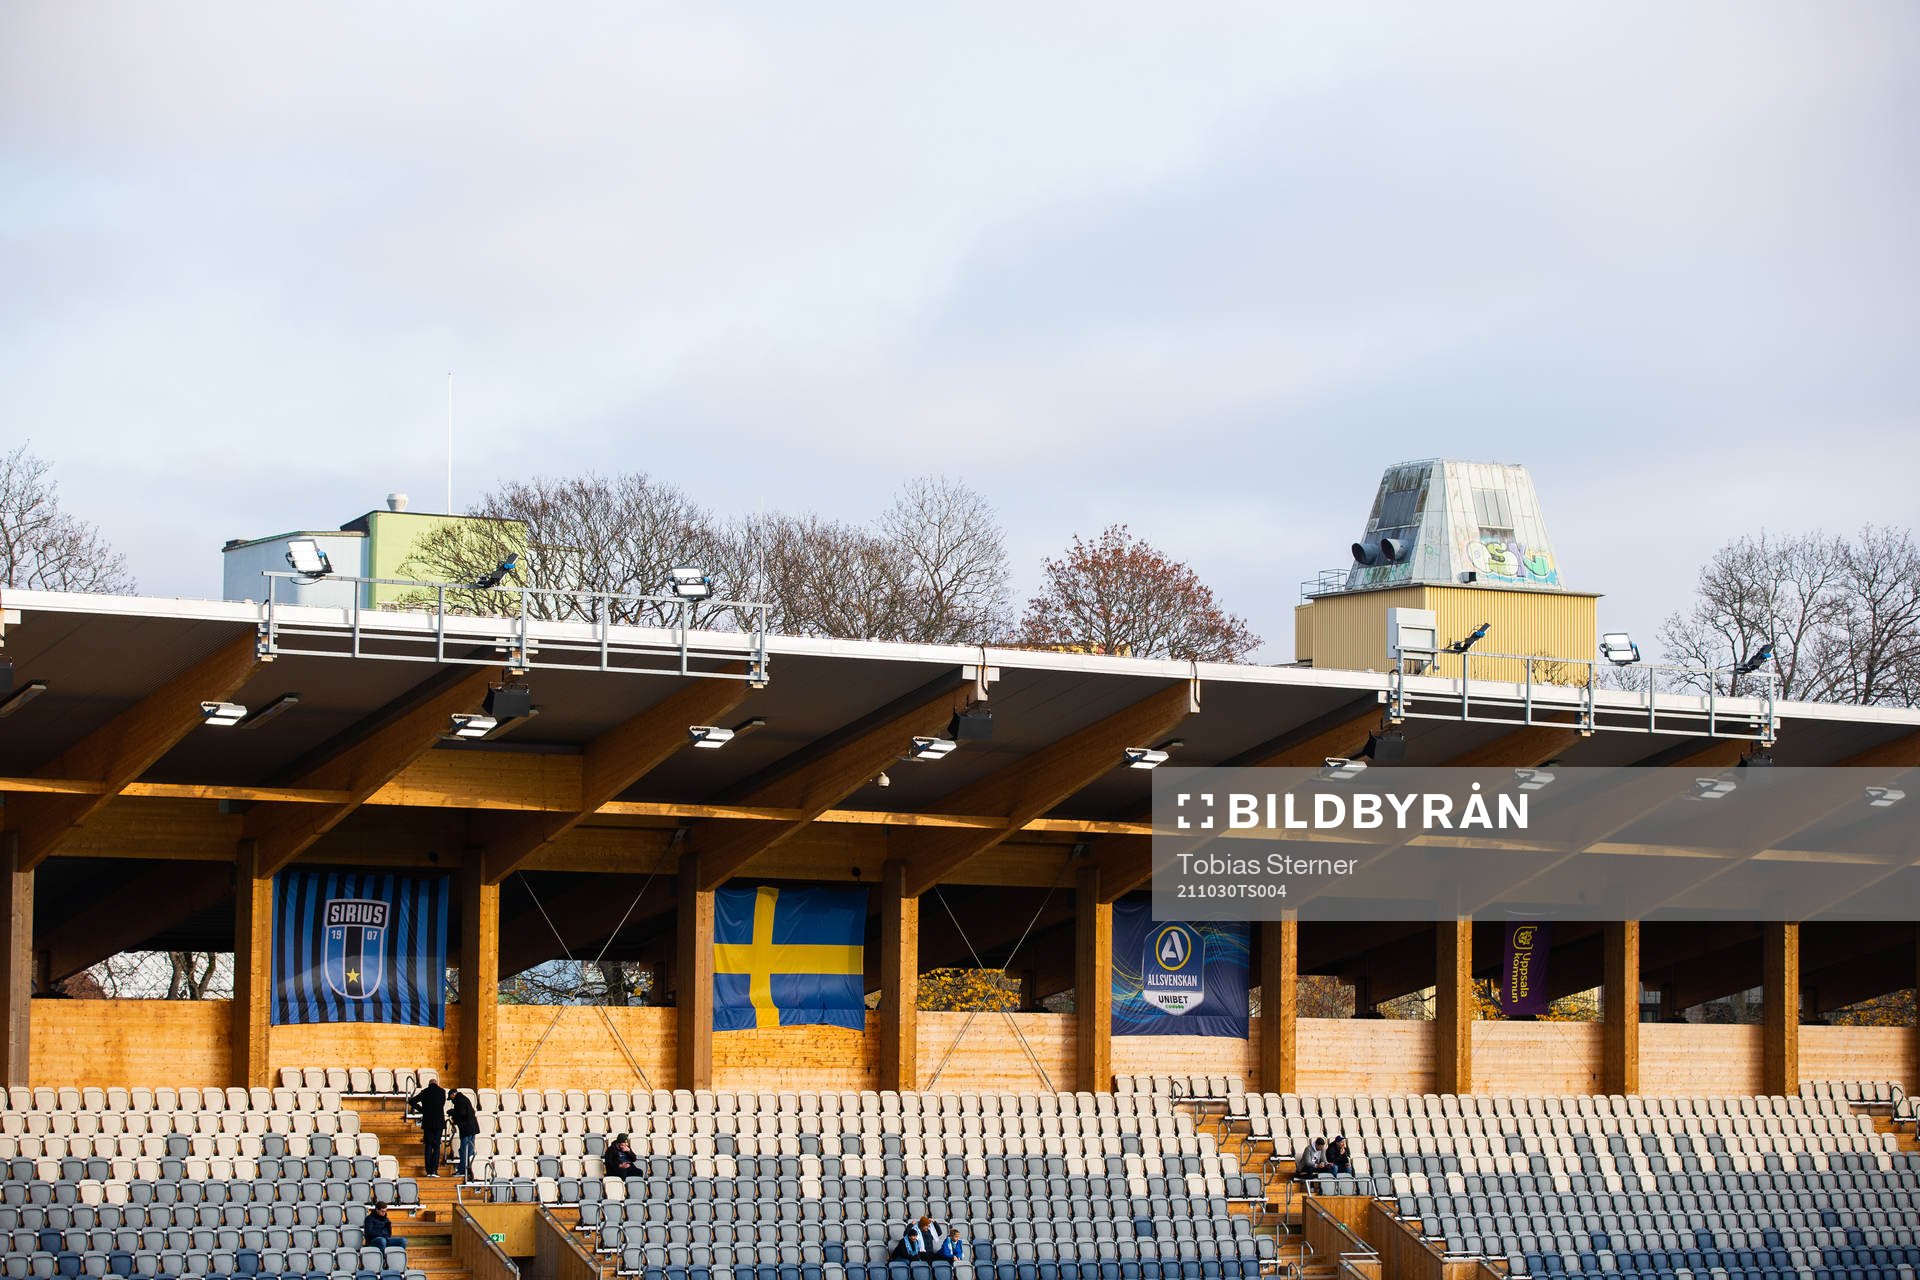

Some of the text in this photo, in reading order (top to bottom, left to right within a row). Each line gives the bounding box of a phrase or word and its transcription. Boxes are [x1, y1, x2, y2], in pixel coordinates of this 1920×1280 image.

[330, 904, 384, 924] SIRIUS
[331, 930, 378, 941] 19 07
[1161, 931, 1184, 962] A
[1147, 974, 1197, 986] ALLSVENSKAN
[1511, 952, 1523, 1003] kommun
[1520, 952, 1532, 998] Uppsala
[1158, 995, 1189, 1004] UNIBET
